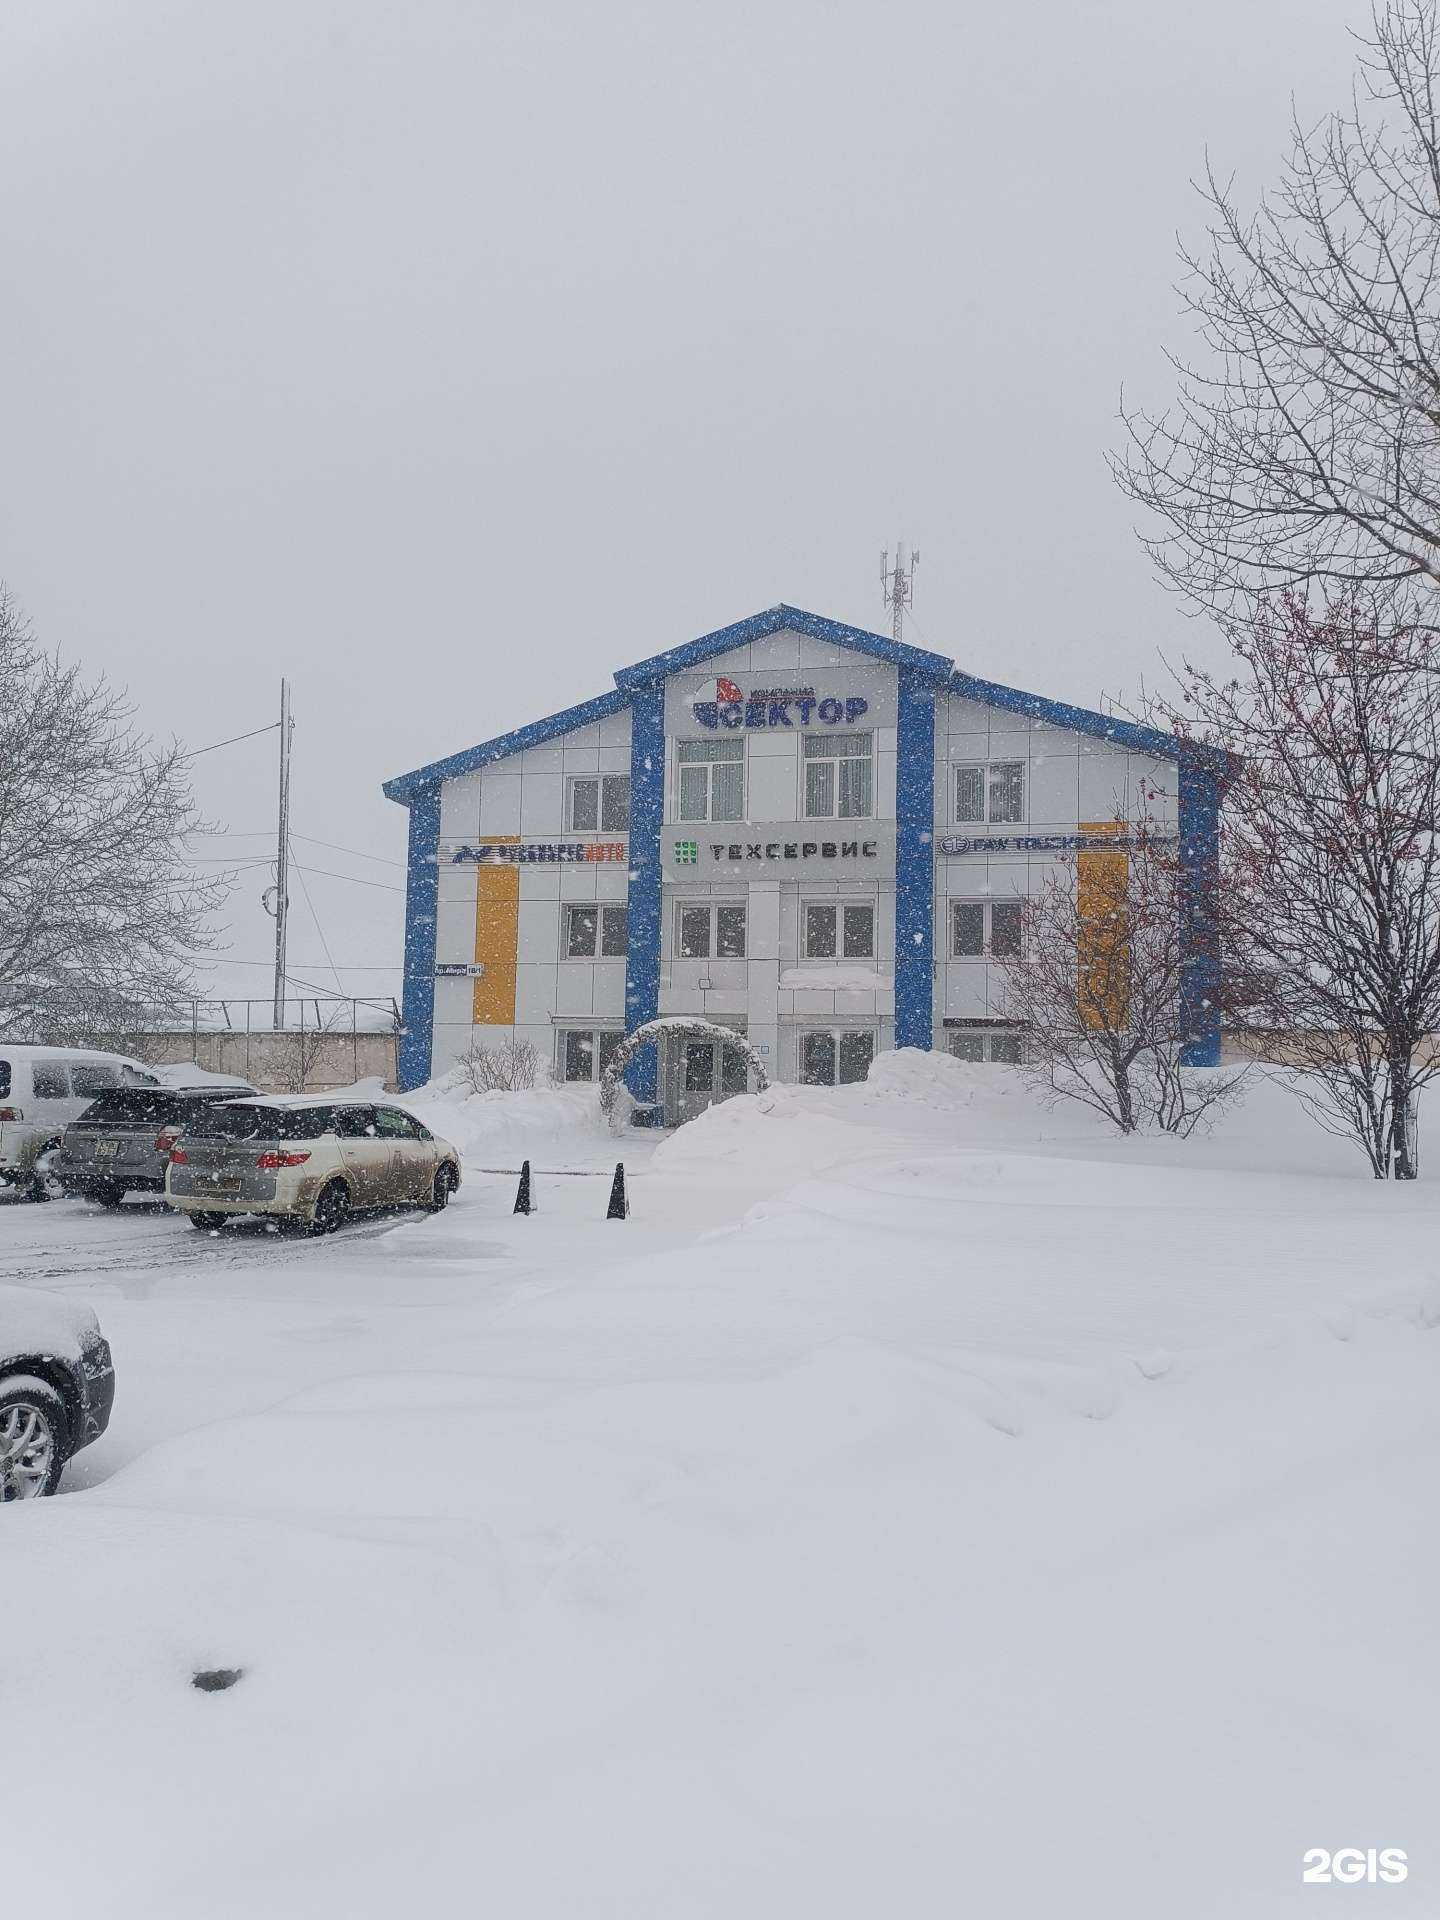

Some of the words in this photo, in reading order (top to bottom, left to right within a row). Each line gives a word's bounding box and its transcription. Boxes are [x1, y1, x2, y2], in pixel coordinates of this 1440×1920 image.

[719, 697, 868, 728] СЕКТОР
[709, 841, 877, 860] ТЕХСЕРВИС
[973, 838, 1009, 851] FAW
